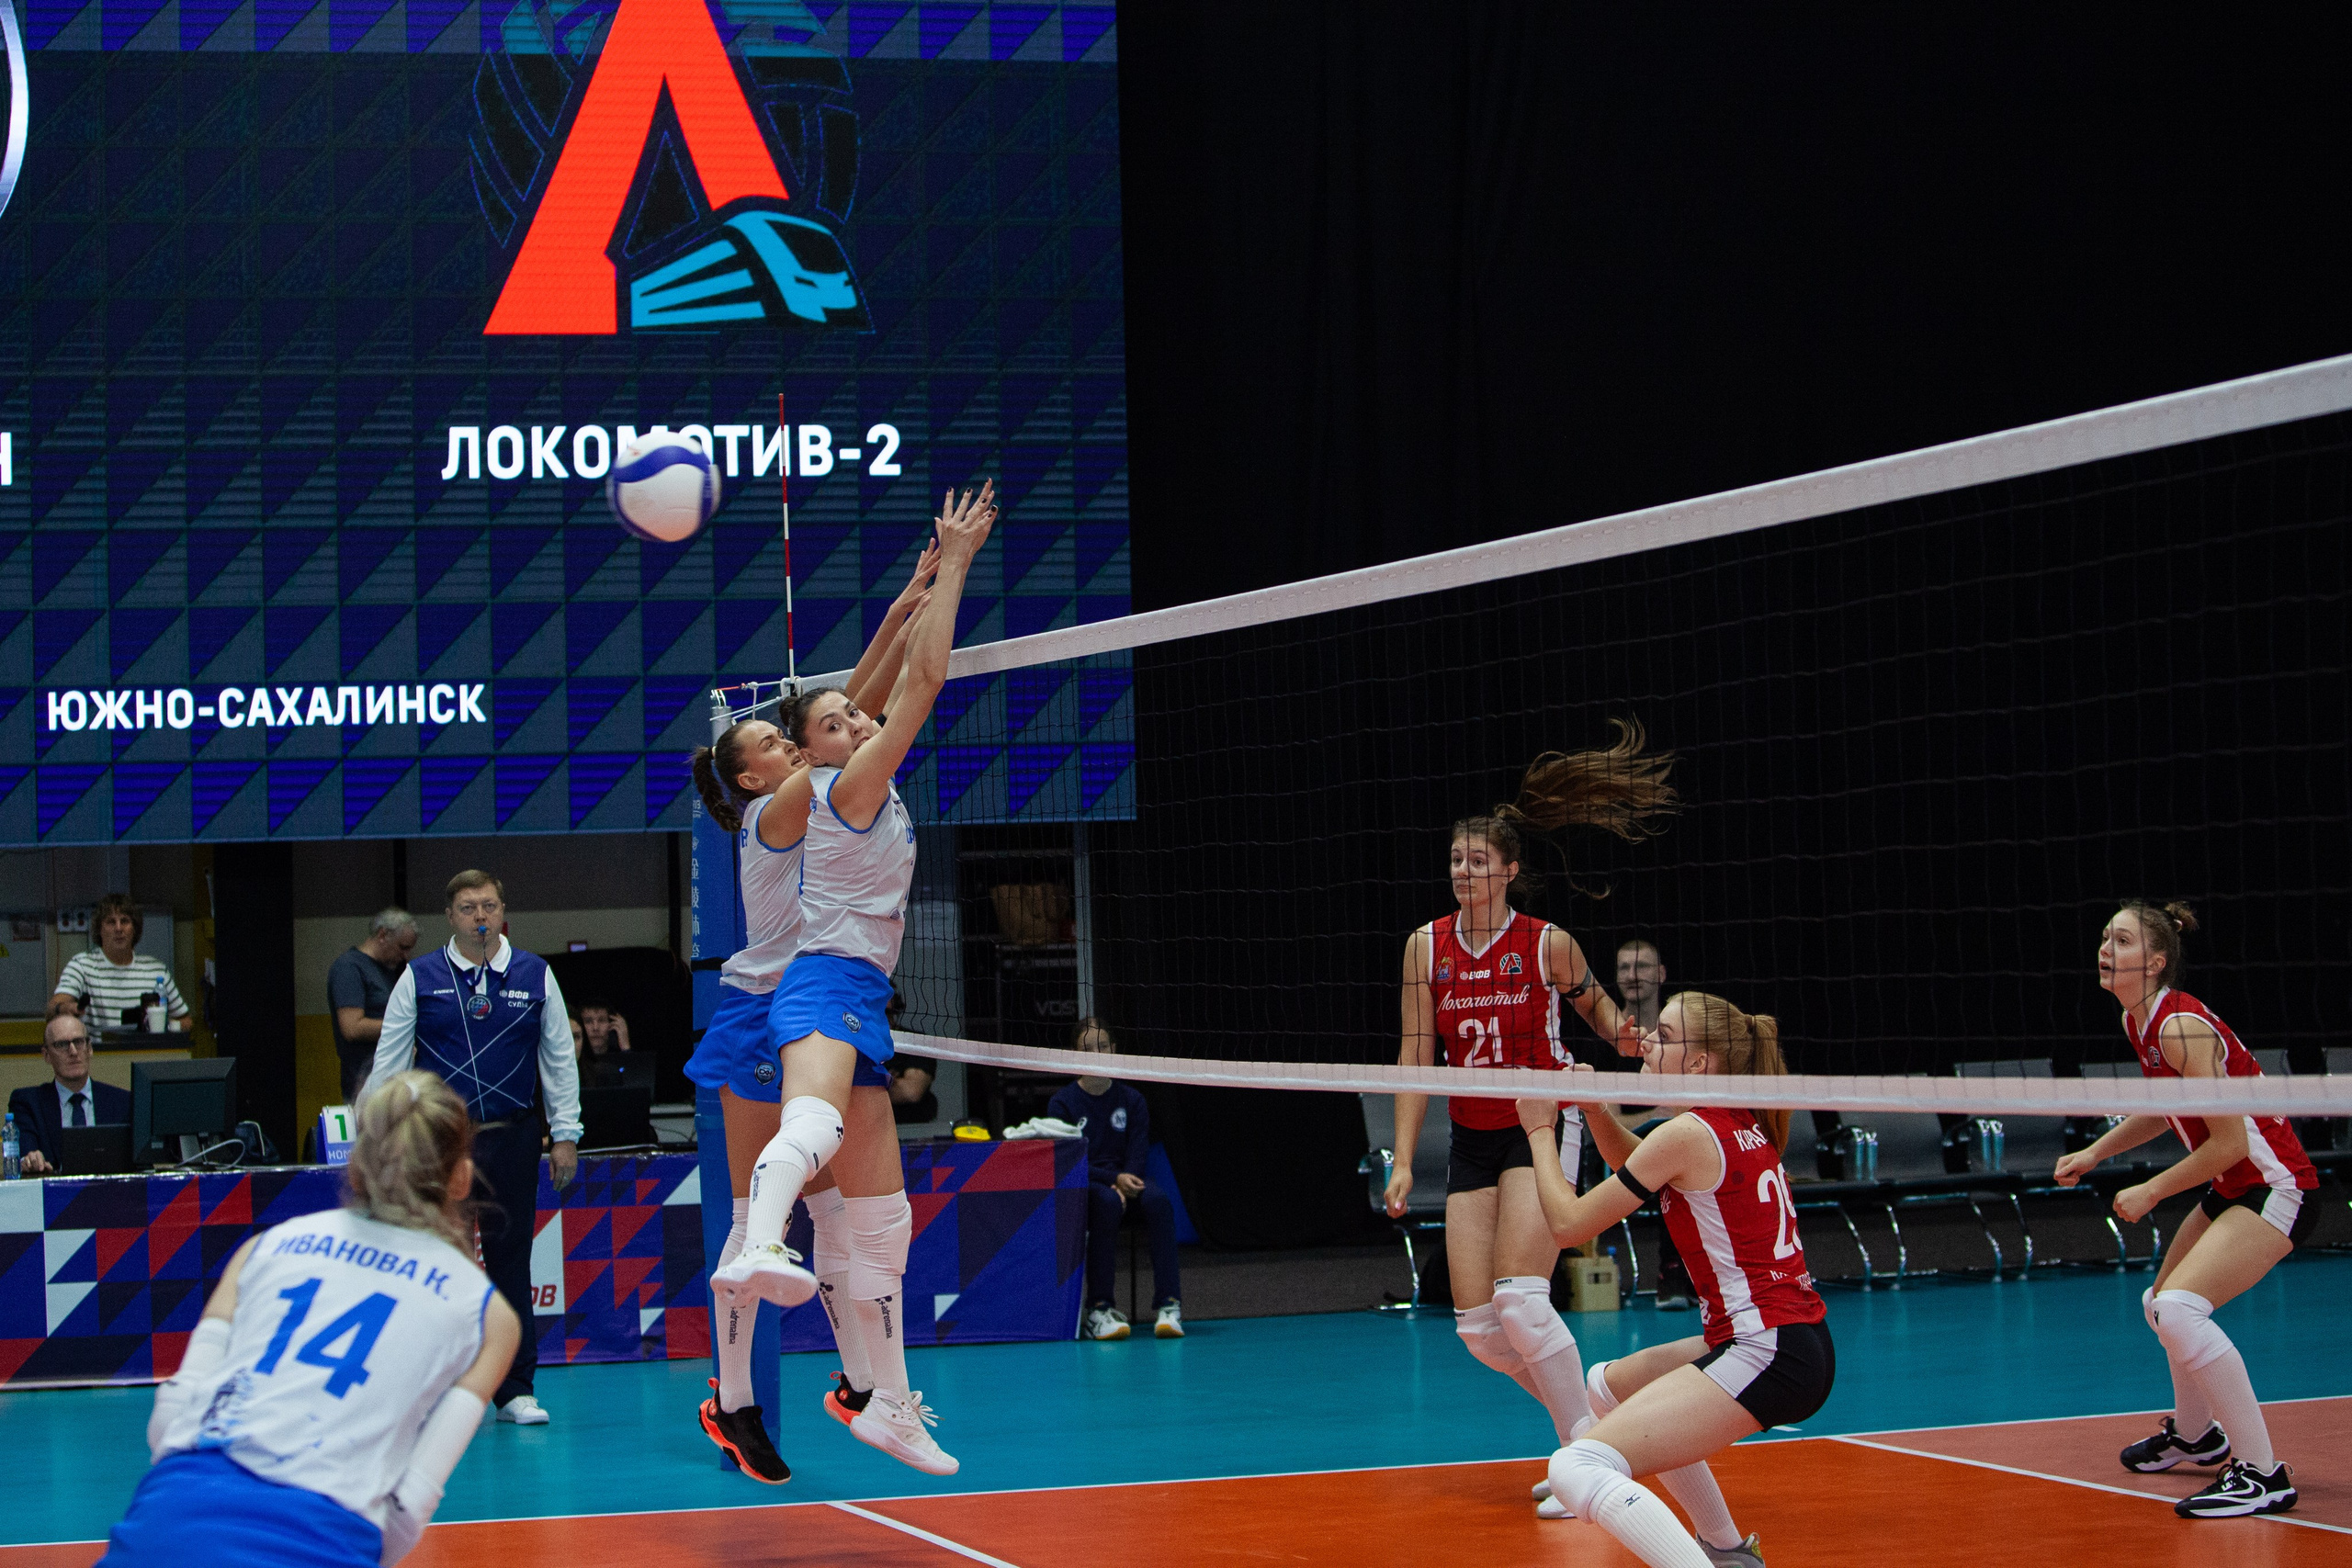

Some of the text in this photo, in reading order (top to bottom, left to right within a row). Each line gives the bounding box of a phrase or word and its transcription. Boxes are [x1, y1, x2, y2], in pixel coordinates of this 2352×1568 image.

[47, 683, 487, 731] ЮЖНО-САХАЛИНСК
[508, 989, 529, 999] ВФВ
[1436, 984, 1531, 1014] Локомотив
[1458, 1016, 1504, 1067] 21
[334, 1114, 348, 1142] 1
[272, 1234, 419, 1280] ИВАНОВА
[253, 1277, 399, 1400] 14
